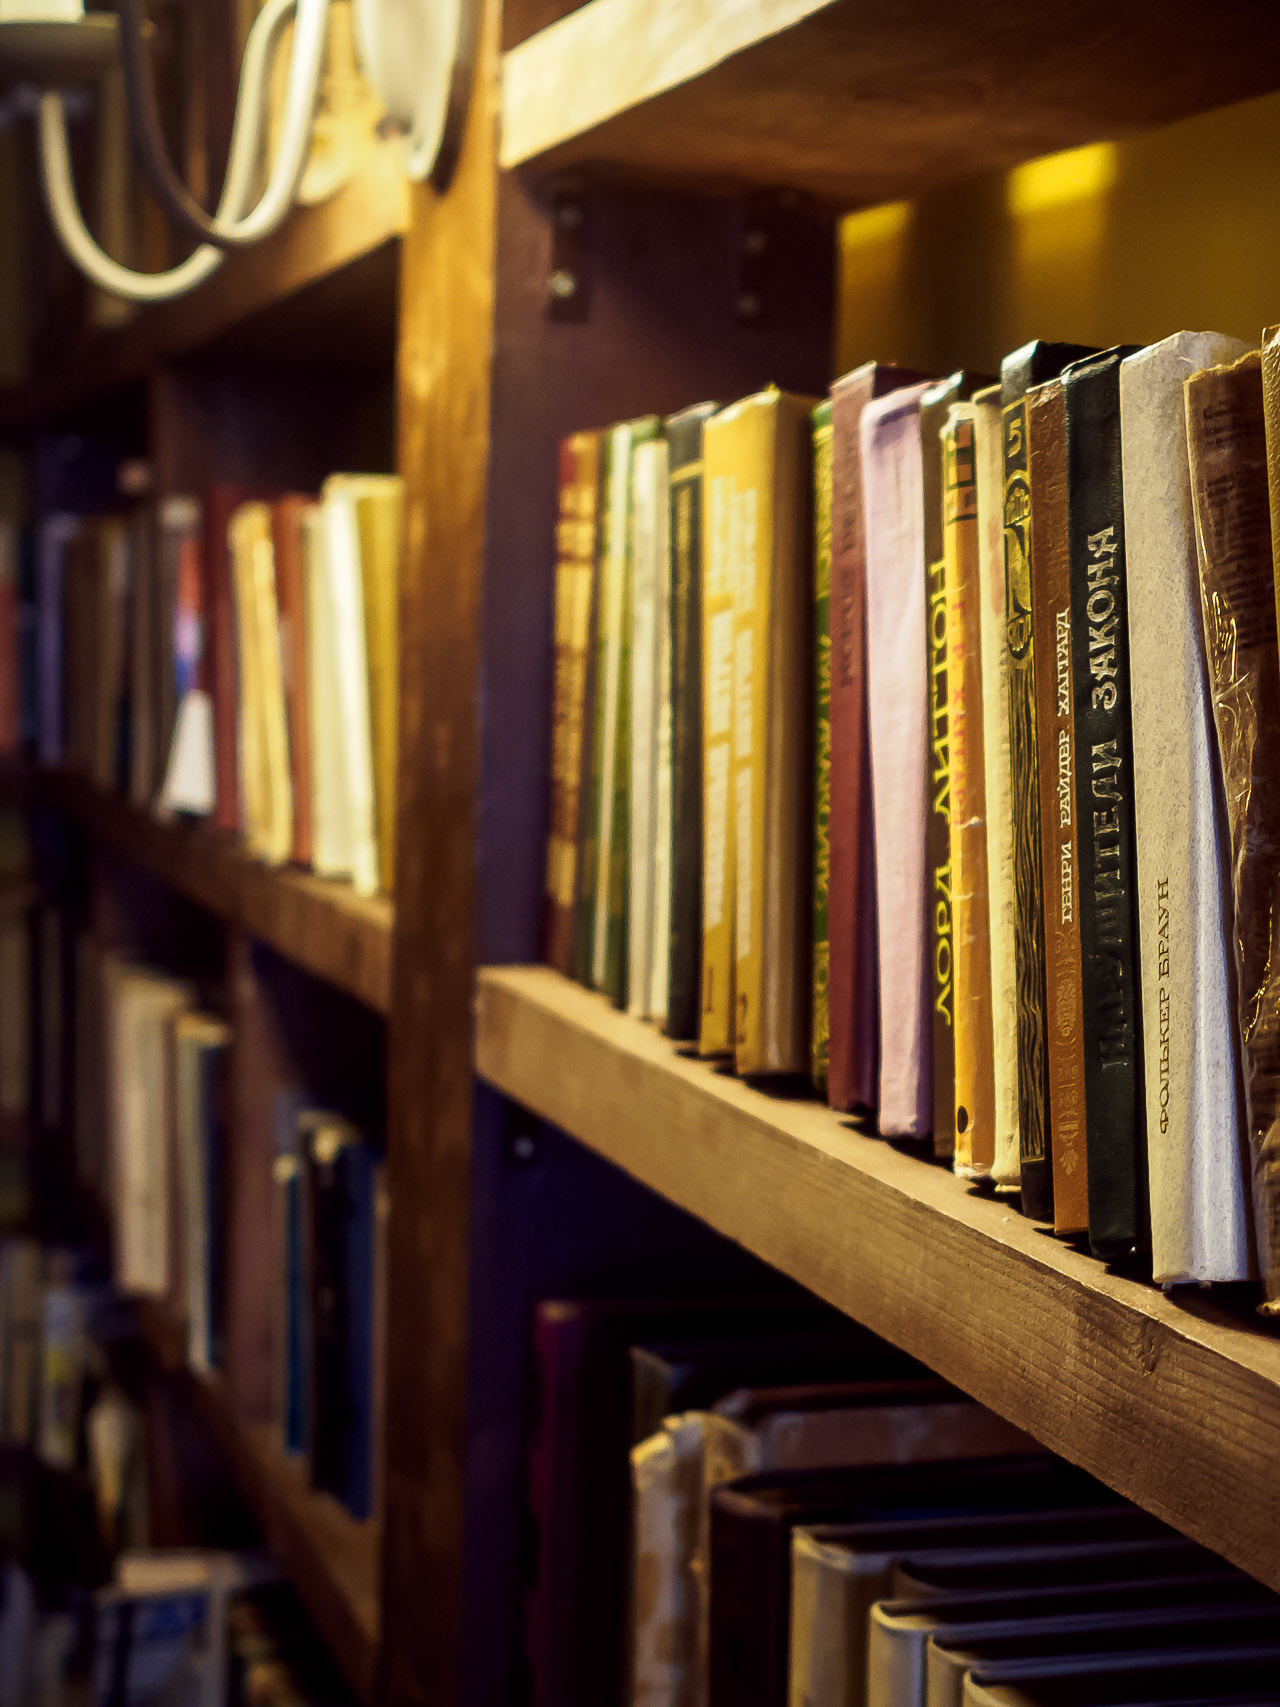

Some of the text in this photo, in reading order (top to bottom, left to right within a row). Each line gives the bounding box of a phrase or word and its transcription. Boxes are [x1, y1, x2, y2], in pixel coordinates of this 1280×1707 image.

[1008, 418, 1022, 458] 5
[1084, 524, 1119, 711] ЗАКОНА
[930, 557, 954, 1025] ЛОРД ЛИТТОН
[1053, 607, 1073, 925] ГЕНРИ РАЙДЕР ХАГГАРД
[1156, 877, 1172, 1135] ФОЛЬКЕР БРАУН
